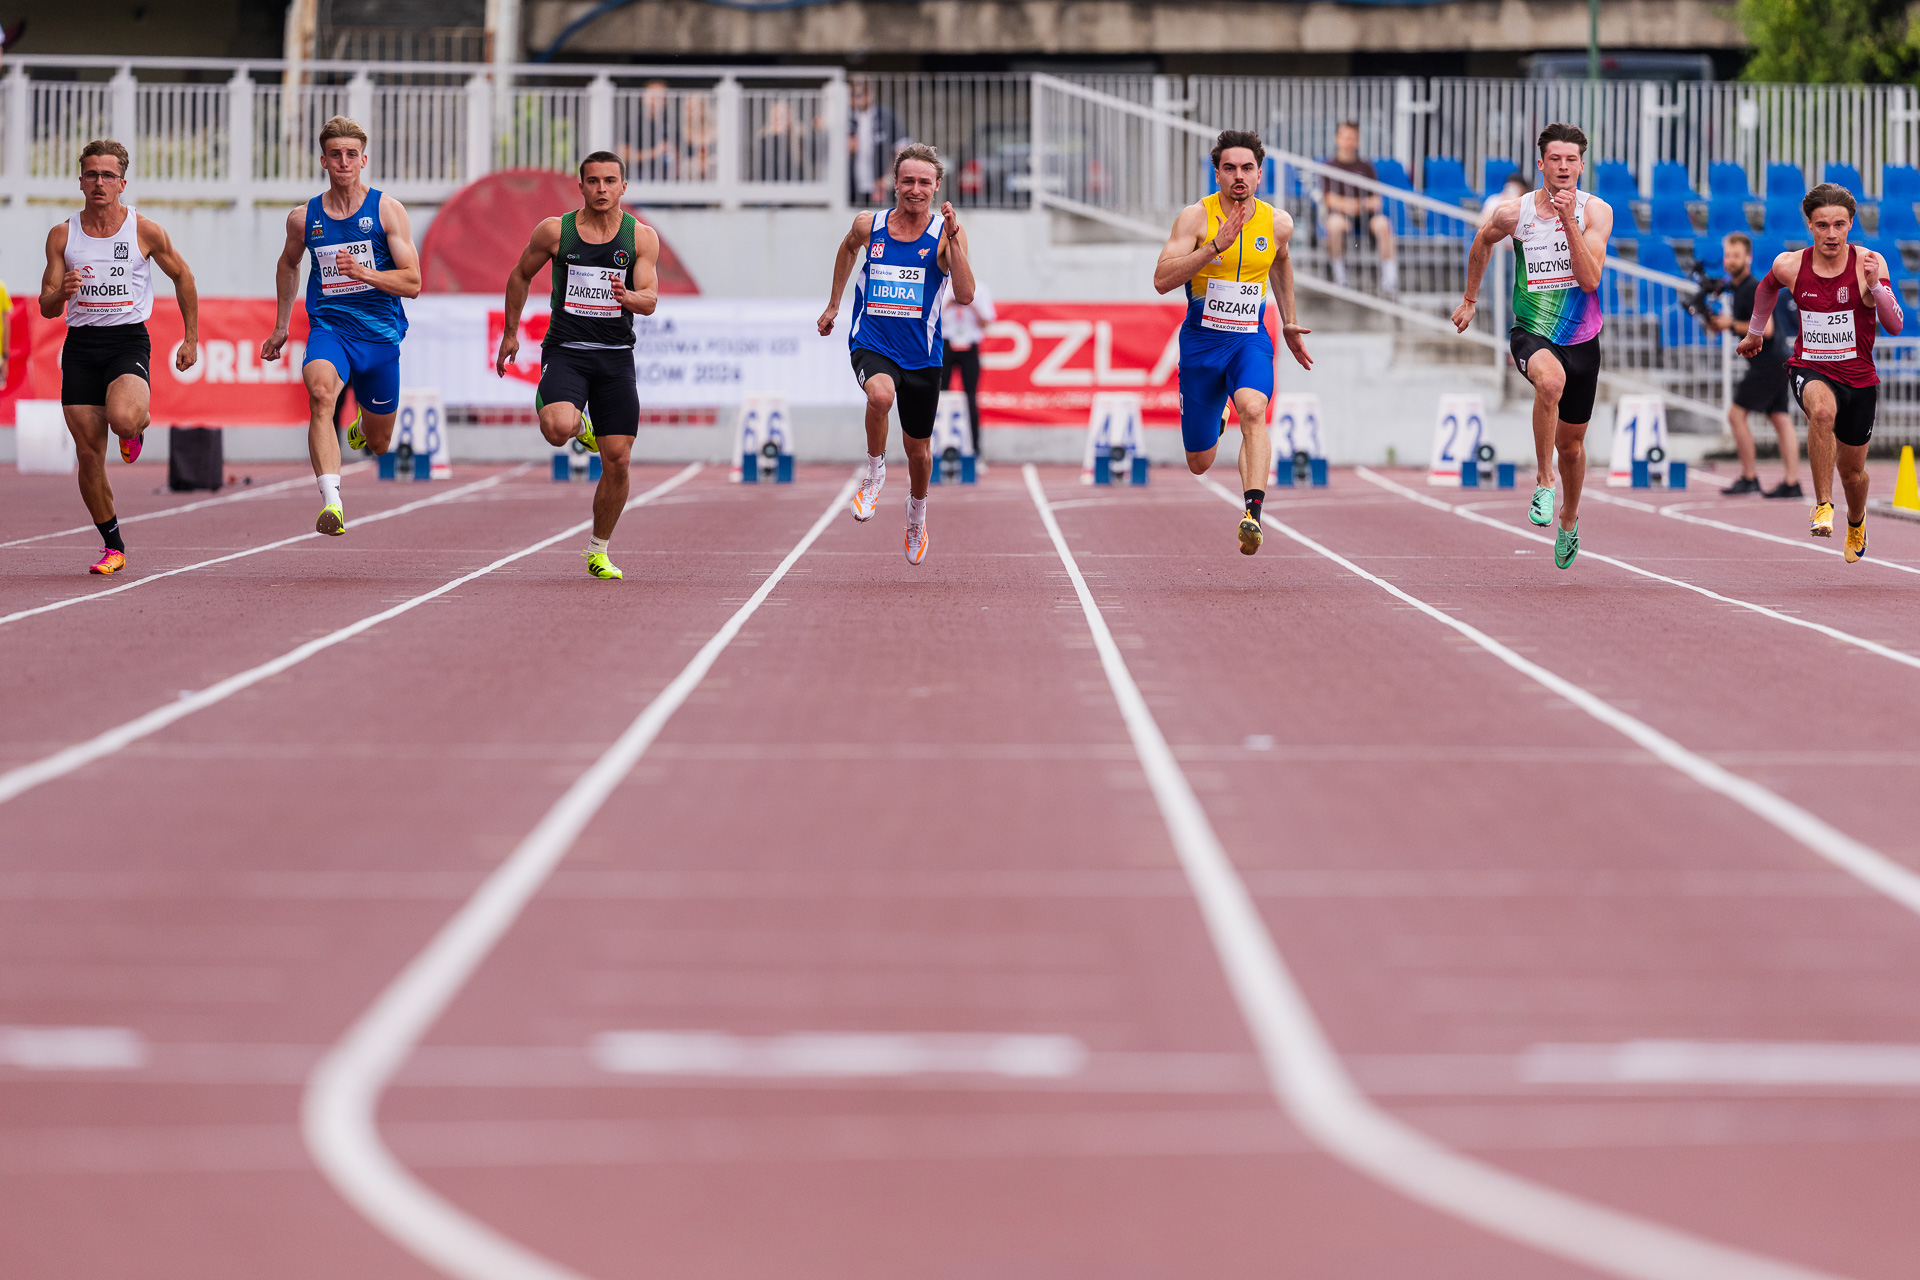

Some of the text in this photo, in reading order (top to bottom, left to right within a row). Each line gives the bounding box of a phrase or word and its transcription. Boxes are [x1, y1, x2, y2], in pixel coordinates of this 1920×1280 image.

[347, 244, 367, 255] 283
[1554, 241, 1570, 252] 16
[110, 267, 124, 277] 20
[1528, 258, 1572, 274] BUCZYŃS
[898, 270, 919, 280] 325
[80, 283, 129, 296] WRÓBEL
[568, 285, 614, 300] ZAKRZEWS
[872, 285, 915, 300] LIBURA
[1240, 285, 1259, 295] 363
[1208, 299, 1256, 316] GRZĄKA
[1828, 314, 1848, 325] 255
[1803, 330, 1854, 344] KOŚCIELNIAK
[1441, 414, 1458, 461] 2
[1623, 415, 1637, 461] 1
